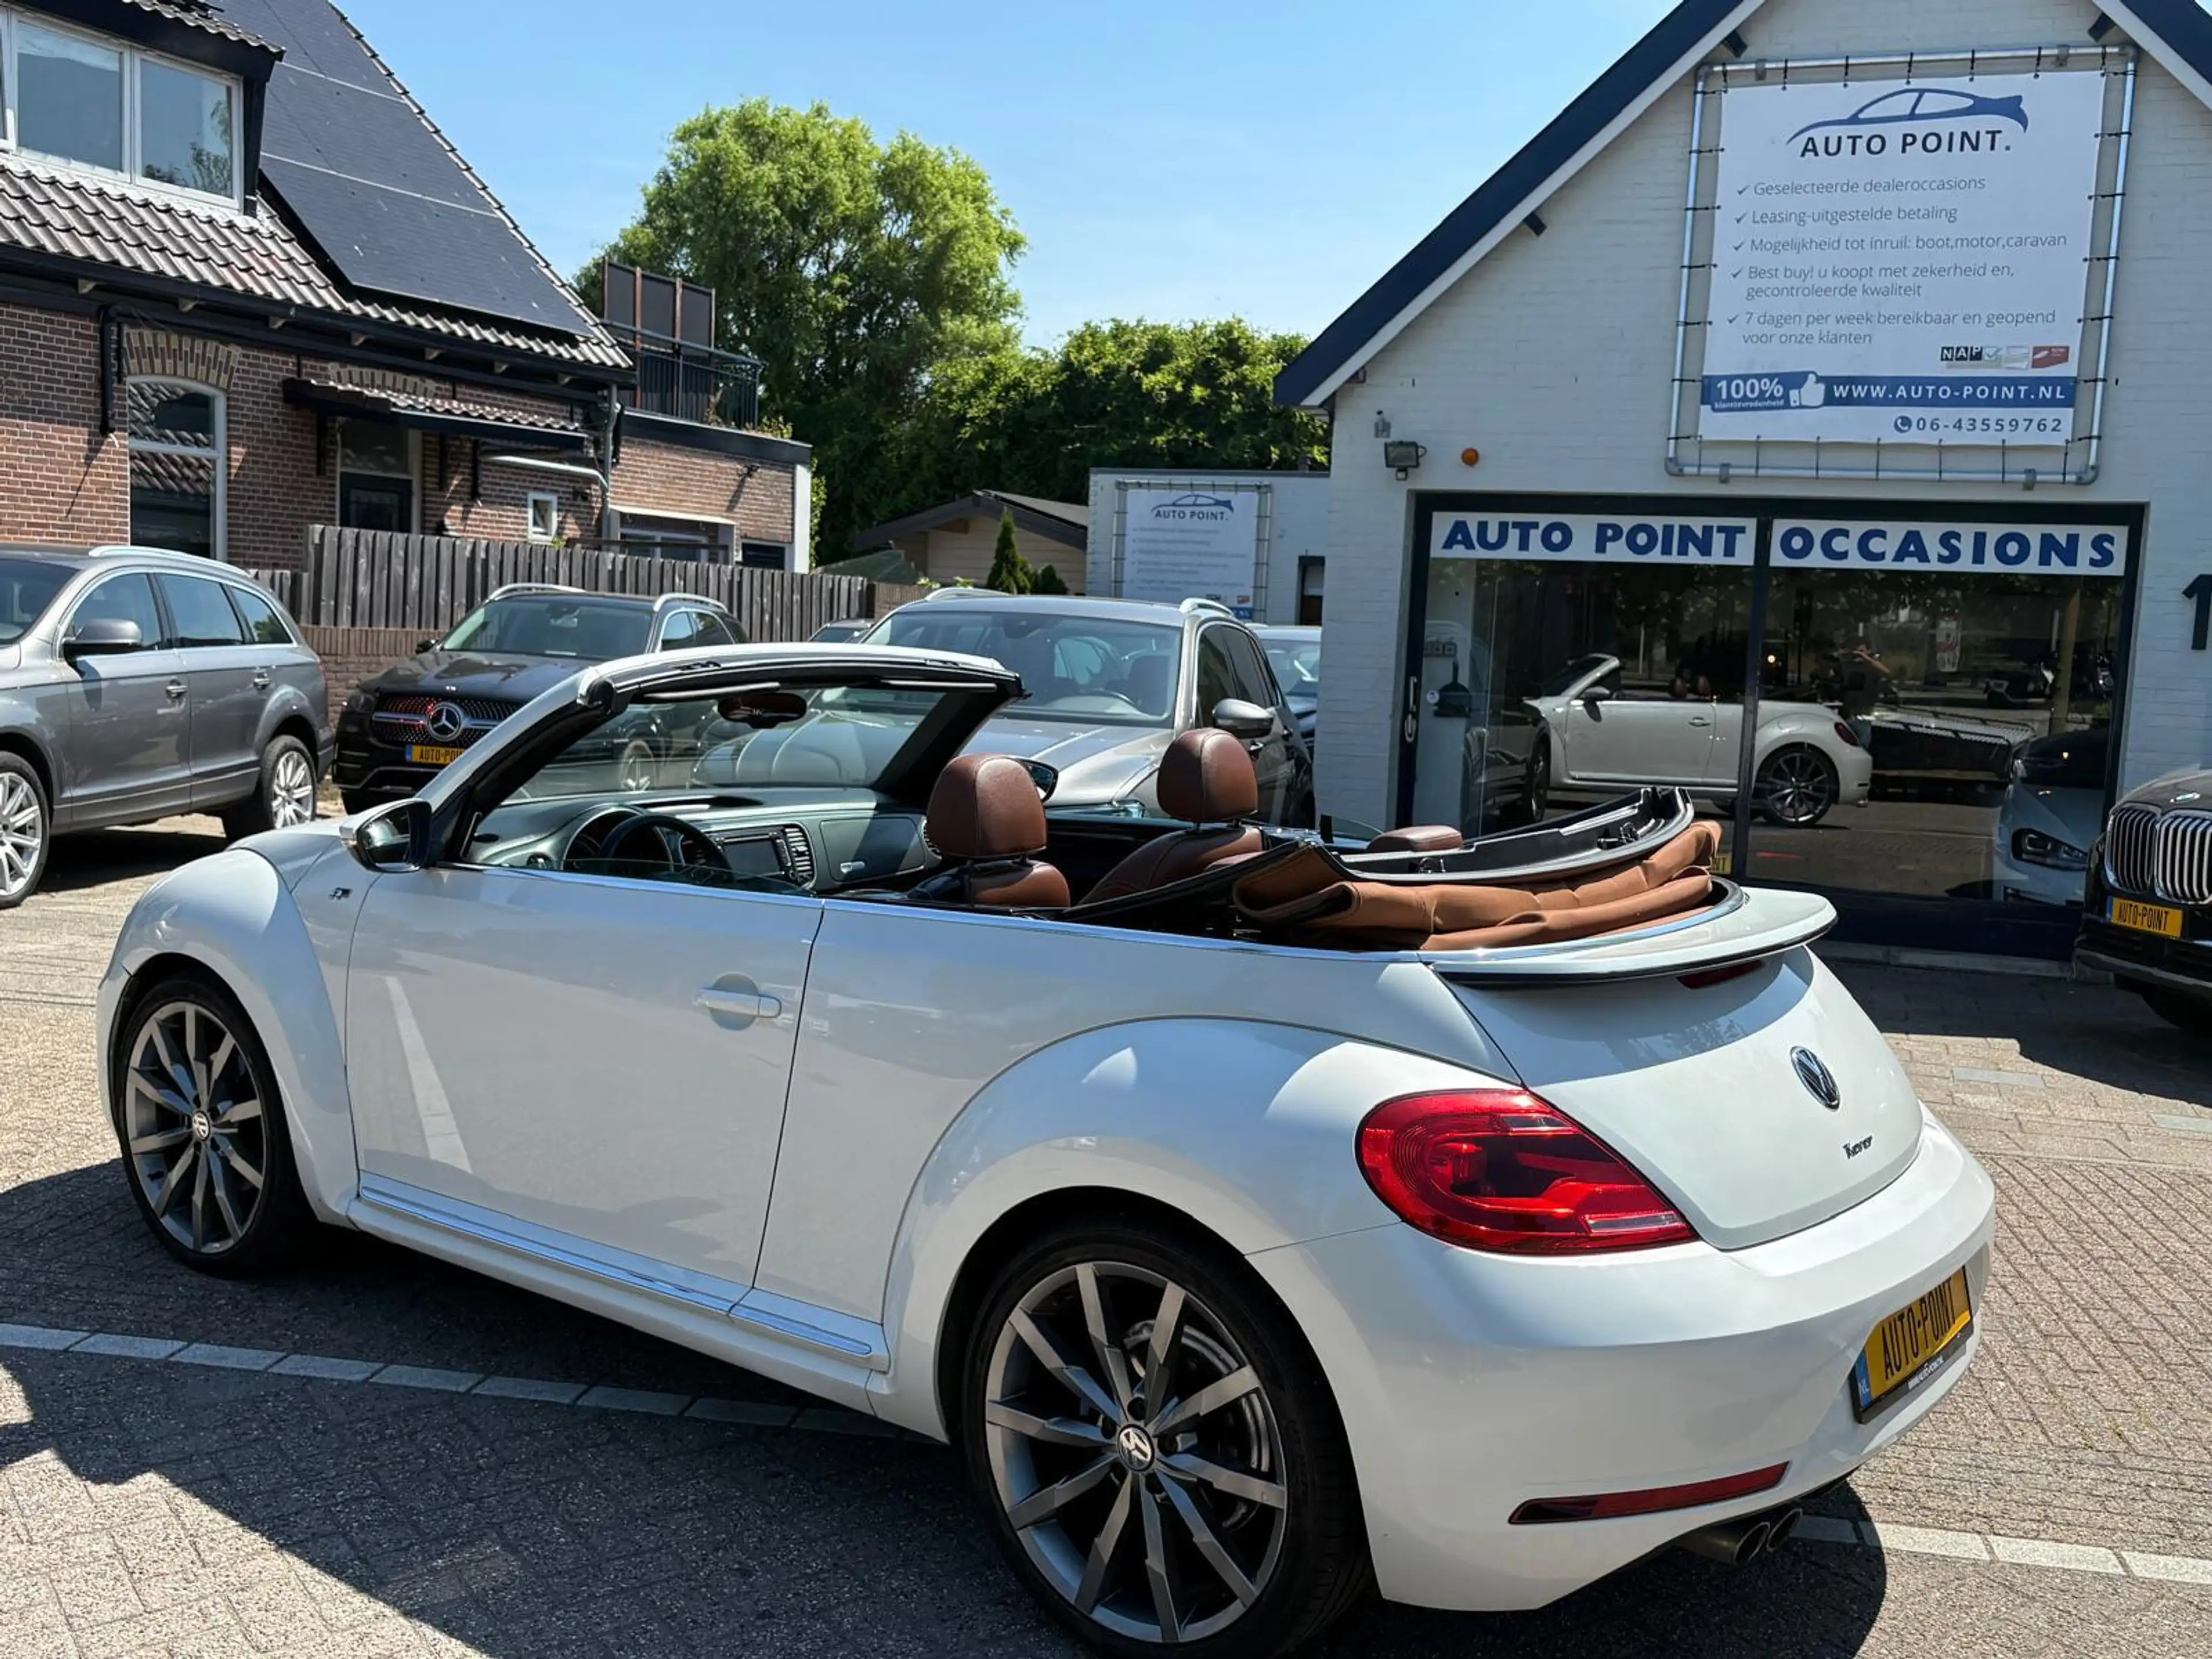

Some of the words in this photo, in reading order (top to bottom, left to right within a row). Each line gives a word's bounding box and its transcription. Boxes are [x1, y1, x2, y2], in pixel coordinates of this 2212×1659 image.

[1800, 134, 1887, 157] AUTO
[1900, 130, 2012, 154] POINT.
[1753, 178, 1859, 196] Geselecteerde
[1863, 176, 1986, 193] dealeroccasions
[1751, 206, 1893, 227] Leasing-uitgestelde
[1897, 205, 1958, 224] betaling
[1749, 237, 1841, 255] Mogelijkheid
[1845, 238, 1865, 251] tot
[1870, 235, 1911, 251] inruil:
[1748, 265, 1780, 279] Best
[1783, 265, 1814, 282] buy!
[1818, 268, 1828, 278] u
[1832, 265, 1873, 281] koopt
[1878, 265, 1908, 278] met
[1911, 263, 1987, 278] zekerheid
[1745, 283, 1858, 301] gecontroleerde
[1861, 282, 1922, 298] kwaliteit
[1745, 312, 1754, 324] 7
[1758, 311, 1802, 328] dagen
[1805, 315, 1834, 328] per
[1835, 311, 1873, 325] week
[1877, 310, 1959, 325] bereikbaar
[1962, 313, 1982, 324] en
[1985, 309, 2056, 328] geopend
[1743, 332, 1775, 344] voor
[1779, 332, 1814, 344] onze
[1818, 329, 1872, 344] klanten
[1941, 346, 1982, 361] NAP
[1716, 377, 1784, 400] 100%
[1832, 384, 2066, 400] WWW.AUTO-POINT.NL
[1916, 417, 2062, 433] 06-43559762
[1154, 509, 1186, 520] AUTO
[1441, 520, 1573, 552] AUTO
[1594, 522, 1746, 558] POINT
[1779, 527, 2116, 567] OCCASIONS
[2116, 901, 2170, 931] AUTO-POINT
[1881, 1277, 1957, 1381] AUTO-POINT
